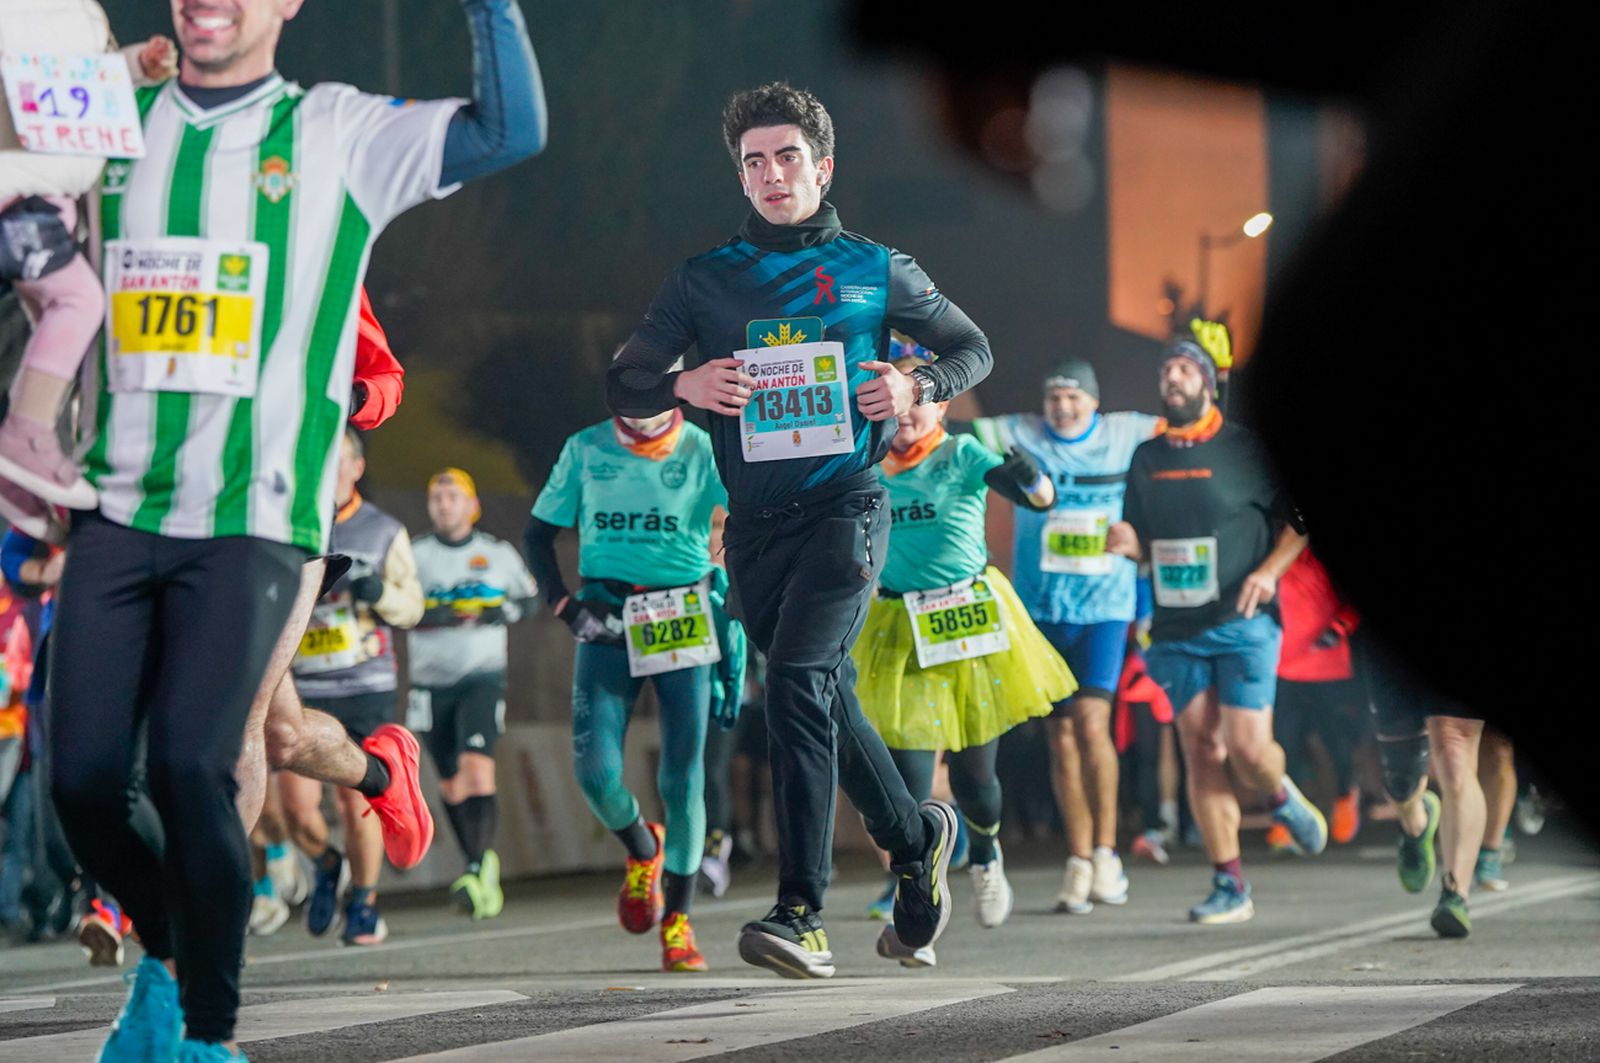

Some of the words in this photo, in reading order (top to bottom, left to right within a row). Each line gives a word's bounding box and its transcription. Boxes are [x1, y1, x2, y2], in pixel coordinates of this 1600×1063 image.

[39, 85, 90, 119] 19
[138, 295, 219, 338] 1761
[760, 364, 790, 377] NOCHE
[792, 363, 804, 373] DE
[771, 374, 806, 388] ANTÓN
[754, 385, 832, 421] 13413
[594, 507, 679, 532] serás
[642, 617, 698, 647] 6282
[929, 602, 988, 635] 5855
